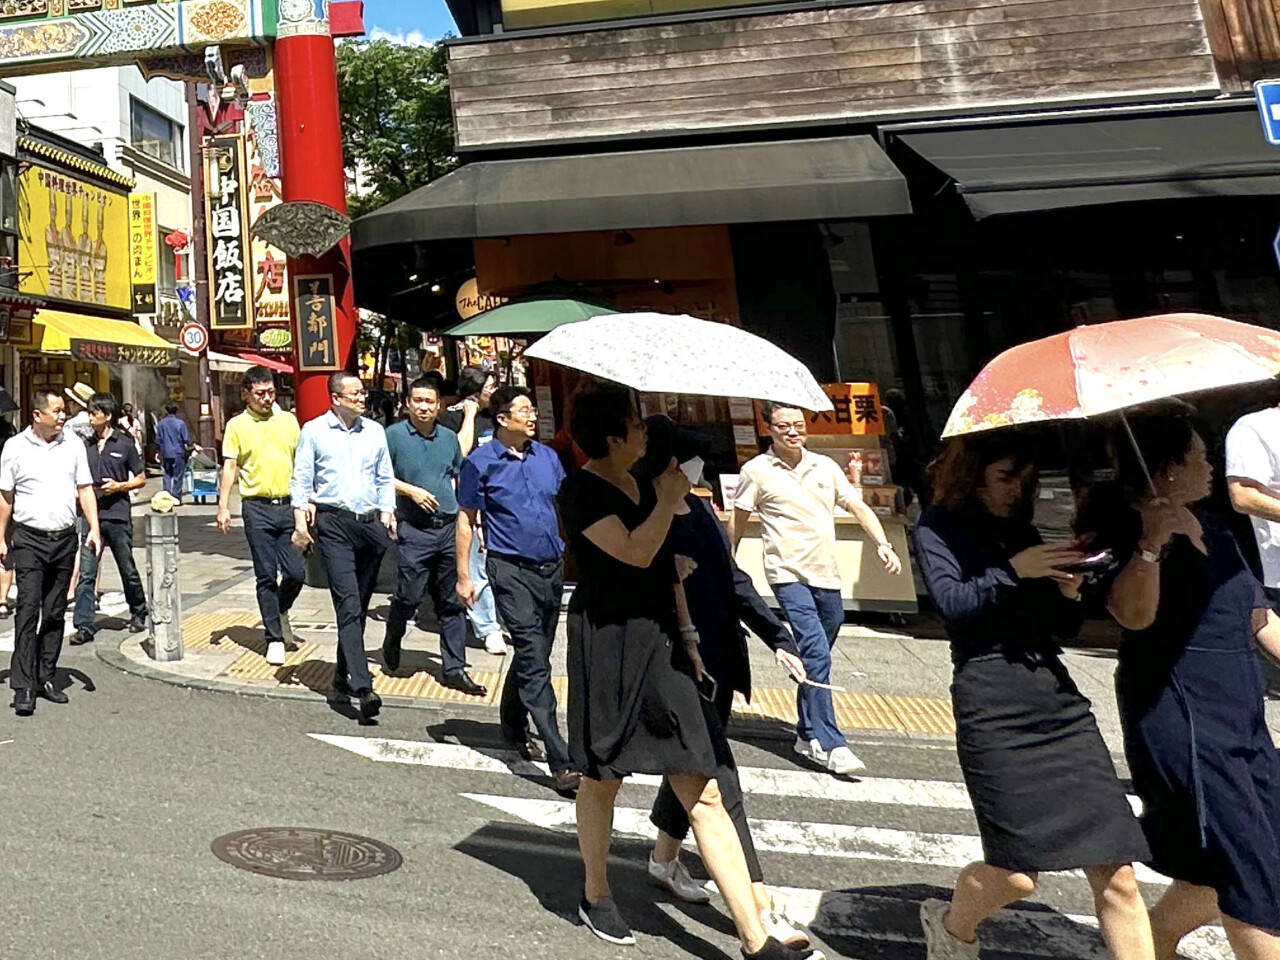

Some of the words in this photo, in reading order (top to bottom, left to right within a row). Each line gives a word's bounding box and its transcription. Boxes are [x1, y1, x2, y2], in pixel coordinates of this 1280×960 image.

[132, 199, 144, 279] 世界一の肉まん
[187, 331, 202, 344] 30
